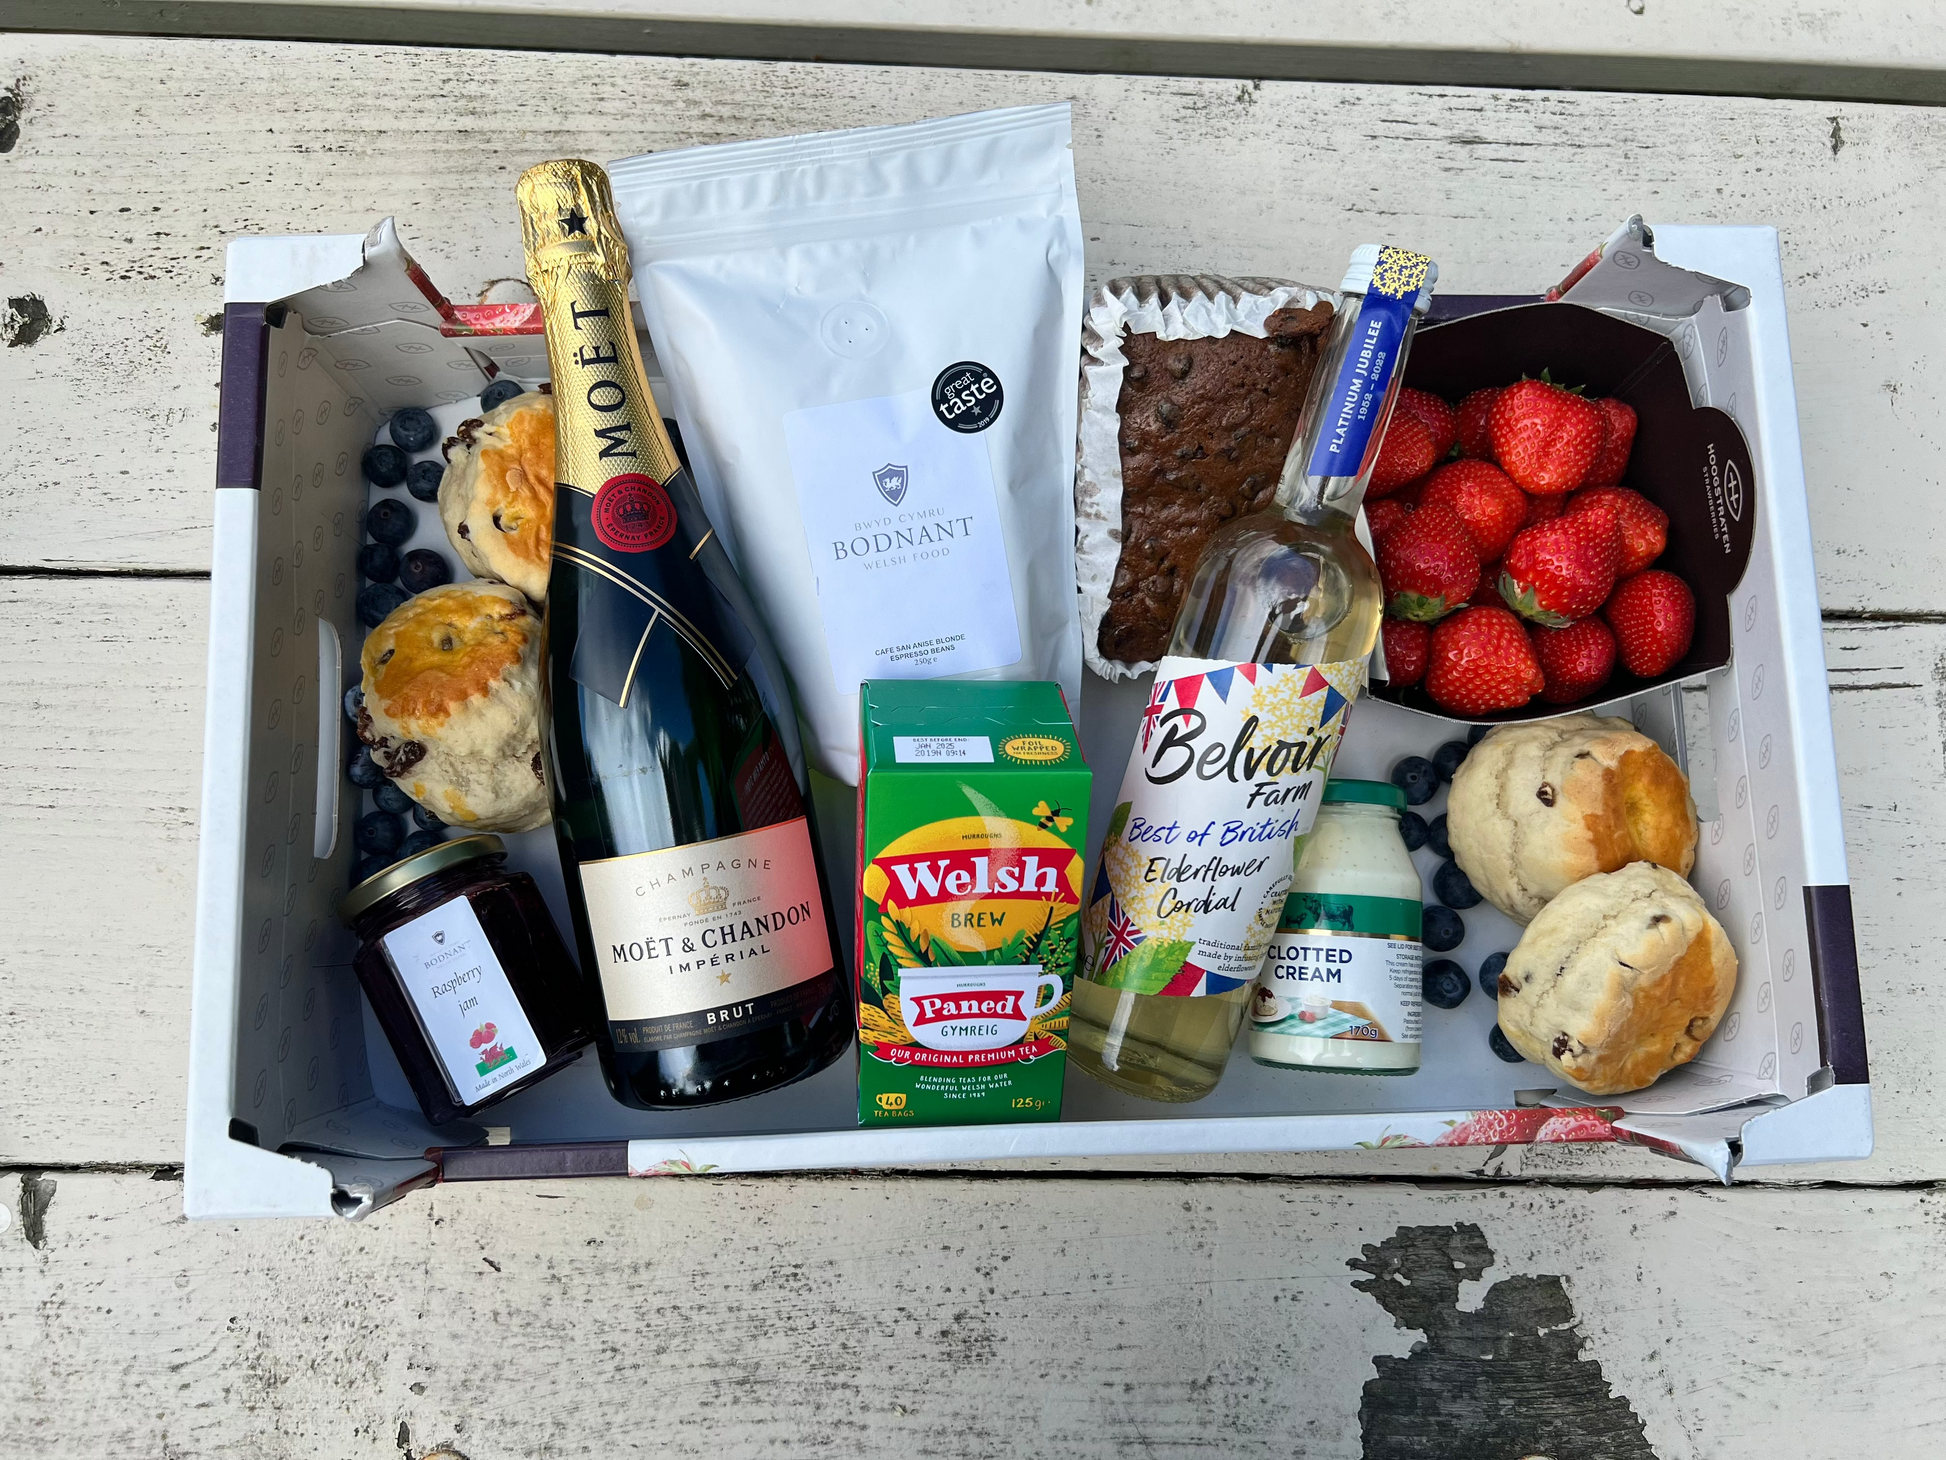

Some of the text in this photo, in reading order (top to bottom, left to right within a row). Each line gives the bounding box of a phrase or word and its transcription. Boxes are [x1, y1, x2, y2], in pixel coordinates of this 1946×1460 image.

[571, 300, 637, 461] MOËT
[944, 372, 975, 400] great
[1329, 320, 1383, 454] PLATINUM JUBILEE
[1357, 393, 1373, 421] 1952
[1371, 351, 1387, 381] 2022
[939, 378, 997, 419] taste
[977, 416, 990, 428] 2019
[604, 494, 617, 513] MOËT
[624, 486, 660, 505] CHANDON
[1702, 466, 1720, 540] STRAWBERRIES
[1707, 443, 1732, 554] HOOGSTRATEN
[606, 516, 666, 541] ÉPERNAY FRANCE
[854, 507, 945, 532] BWYD CYMRU
[832, 516, 973, 561] BODNANT
[863, 547, 950, 571] WELSH FOOD
[875, 633, 966, 656] CAFE SAN ANISE BLONDE
[890, 644, 956, 662] ESPRESSO BEANS
[914, 656, 932, 666] 250g
[945, 749, 966, 757] 09:14
[1145, 708, 1331, 785] Belvoir
[1246, 781, 1313, 809] Farm
[1128, 808, 1301, 847] Best of British
[635, 858, 772, 897] CHAMPAGNE
[891, 856, 1059, 900] Welsh
[1144, 854, 1270, 883] Elderflower
[659, 896, 762, 923] ÉPERNAY FRANCE
[1157, 885, 1242, 919] Cordial
[683, 917, 709, 927] FONDÉ
[725, 911, 742, 919] 1743
[951, 912, 1006, 928] BREW
[611, 901, 811, 964] MOËT & CHANDON
[1198, 937, 1243, 950] traditional
[669, 944, 770, 975] IMPÉRIAL
[1198, 950, 1221, 959] made
[1223, 953, 1233, 962] by
[1267, 945, 1353, 964] CLOTTED
[430, 965, 482, 999] Raspberry
[1274, 965, 1342, 983] CREAM
[458, 995, 479, 1019] jam
[706, 1003, 754, 1024] BRUT
[921, 995, 1016, 1019] Paned
[672, 1020, 694, 1031] FRANCE
[941, 1024, 998, 1037] GYMREIG
[1349, 1025, 1378, 1039] 170g
[890, 1045, 1038, 1064] OUR ORIGINAL PREMIUM TEA
[475, 1079, 490, 1093] Made
[498, 1066, 515, 1081] North
[515, 1058, 531, 1071] Wales
[915, 1082, 958, 1091] WONDERFUL
[988, 1080, 1013, 1089] WATER
[920, 1075, 956, 1083] BLENDING
[885, 1098, 903, 1107] 40
